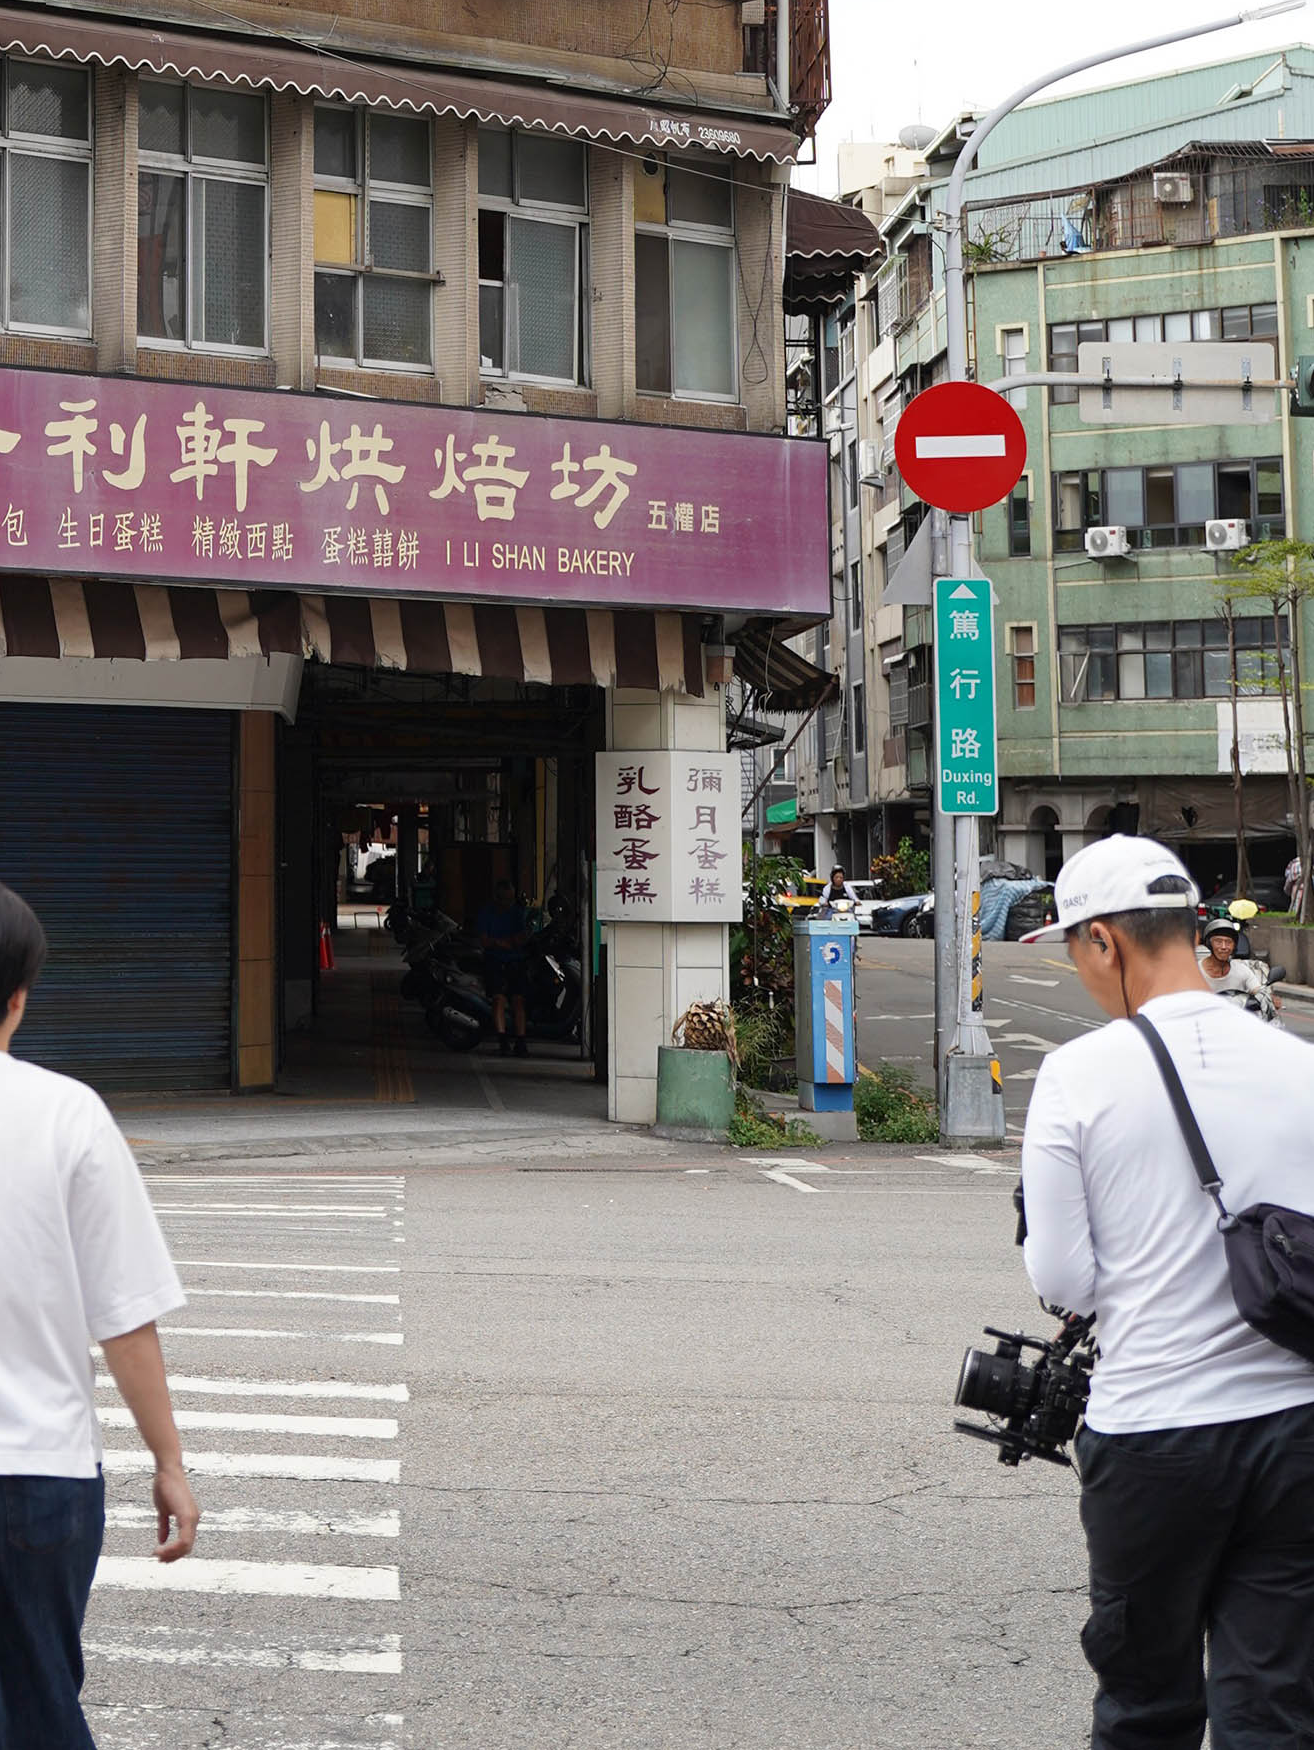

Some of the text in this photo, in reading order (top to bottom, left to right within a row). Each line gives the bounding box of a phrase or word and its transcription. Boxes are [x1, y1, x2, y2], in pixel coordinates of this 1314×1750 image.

[698, 126, 741, 145] 23609680
[57, 506, 164, 553] 生日蛋糕
[191, 515, 294, 562] 精緻西點
[321, 526, 420, 571] 蛋糕囍餅
[446, 540, 451, 565] I
[464, 541, 479, 567] LI
[492, 543, 546, 571] SHAN
[558, 547, 636, 577] BAKERY
[647, 500, 720, 534] 五權店
[949, 610, 981, 759] 篤行路
[942, 769, 992, 786] Duxing
[957, 791, 980, 805] Rd.
[613, 766, 662, 905] 乳酪蛋糕
[687, 768, 728, 905] 彌月蛋糕
